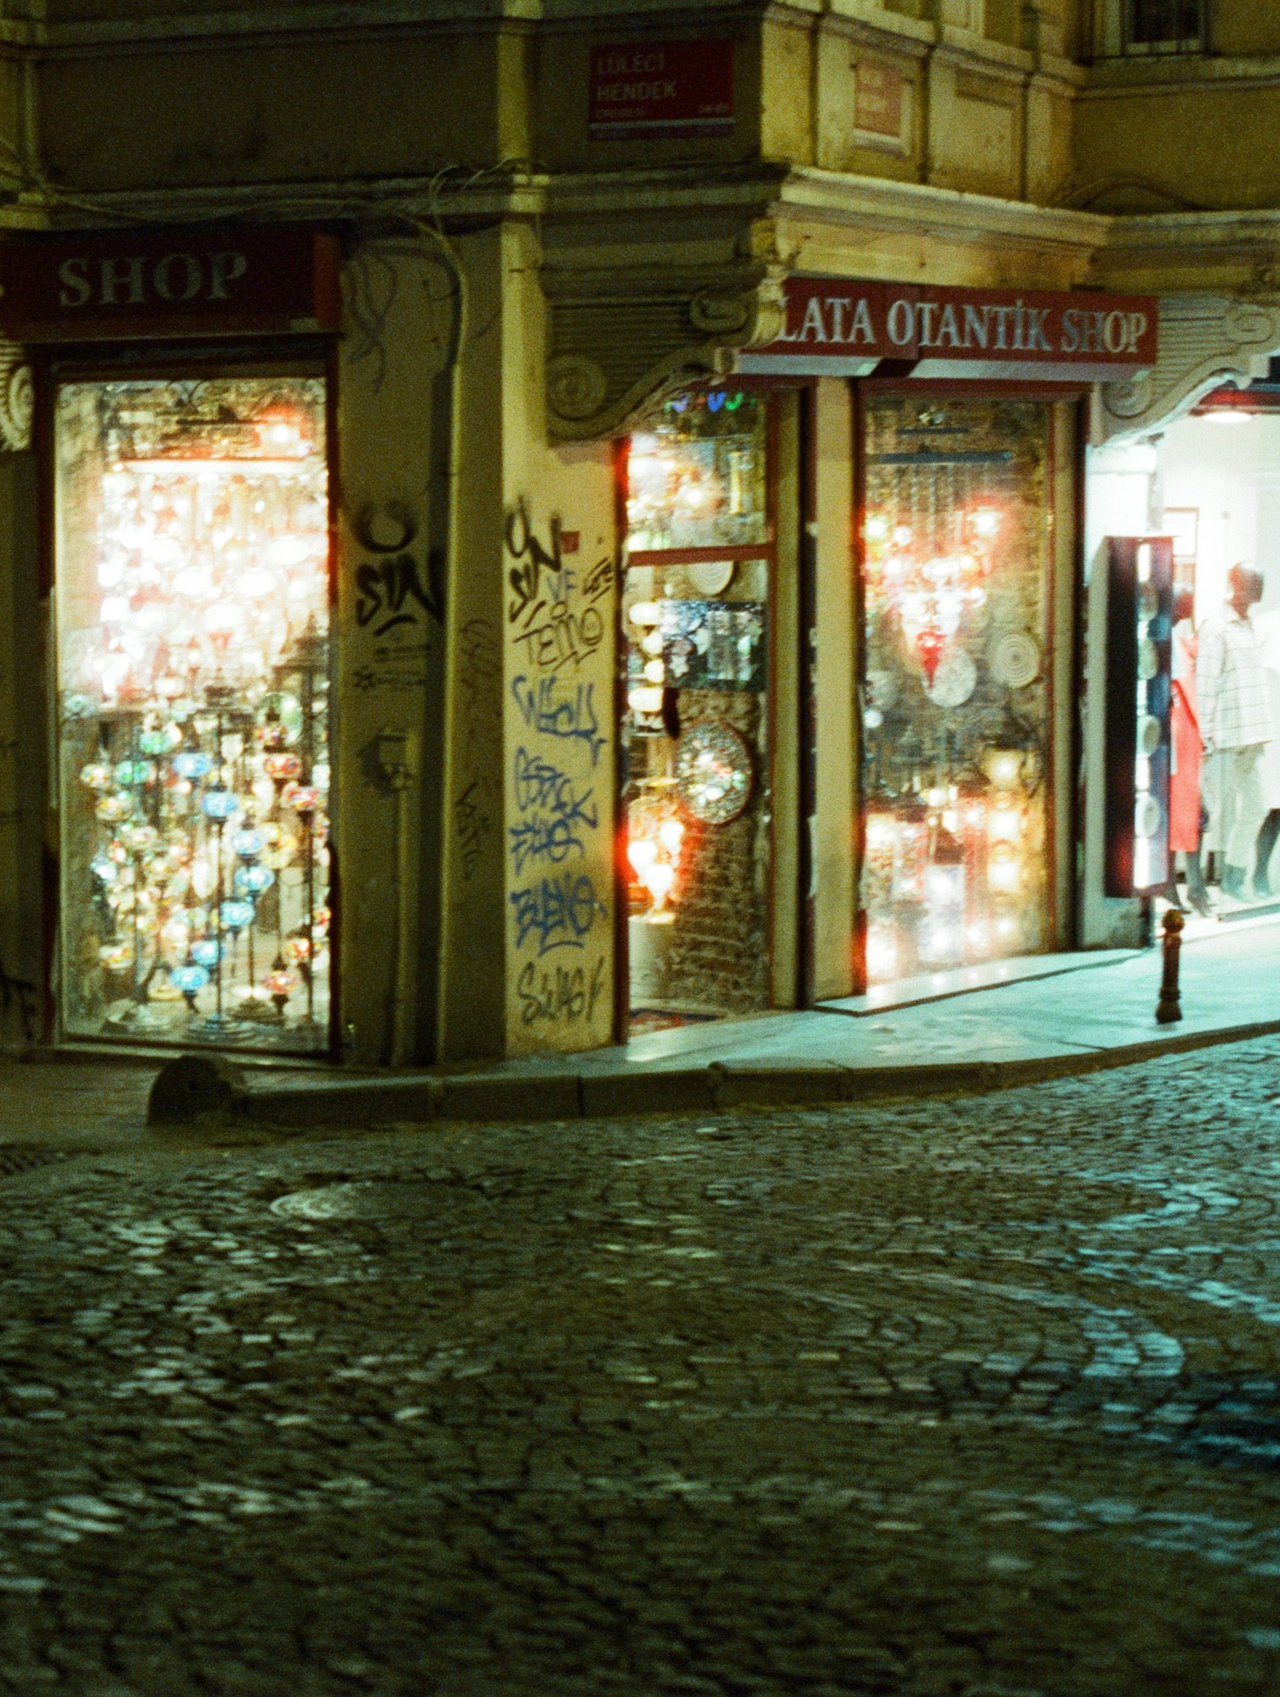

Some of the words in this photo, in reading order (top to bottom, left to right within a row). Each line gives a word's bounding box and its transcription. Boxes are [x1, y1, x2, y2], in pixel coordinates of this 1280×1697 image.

[596, 79, 678, 102] HENDEK
[57, 249, 249, 307] SHOP
[885, 299, 1054, 351] OTANTİK
[1059, 308, 1148, 354] SHOP
